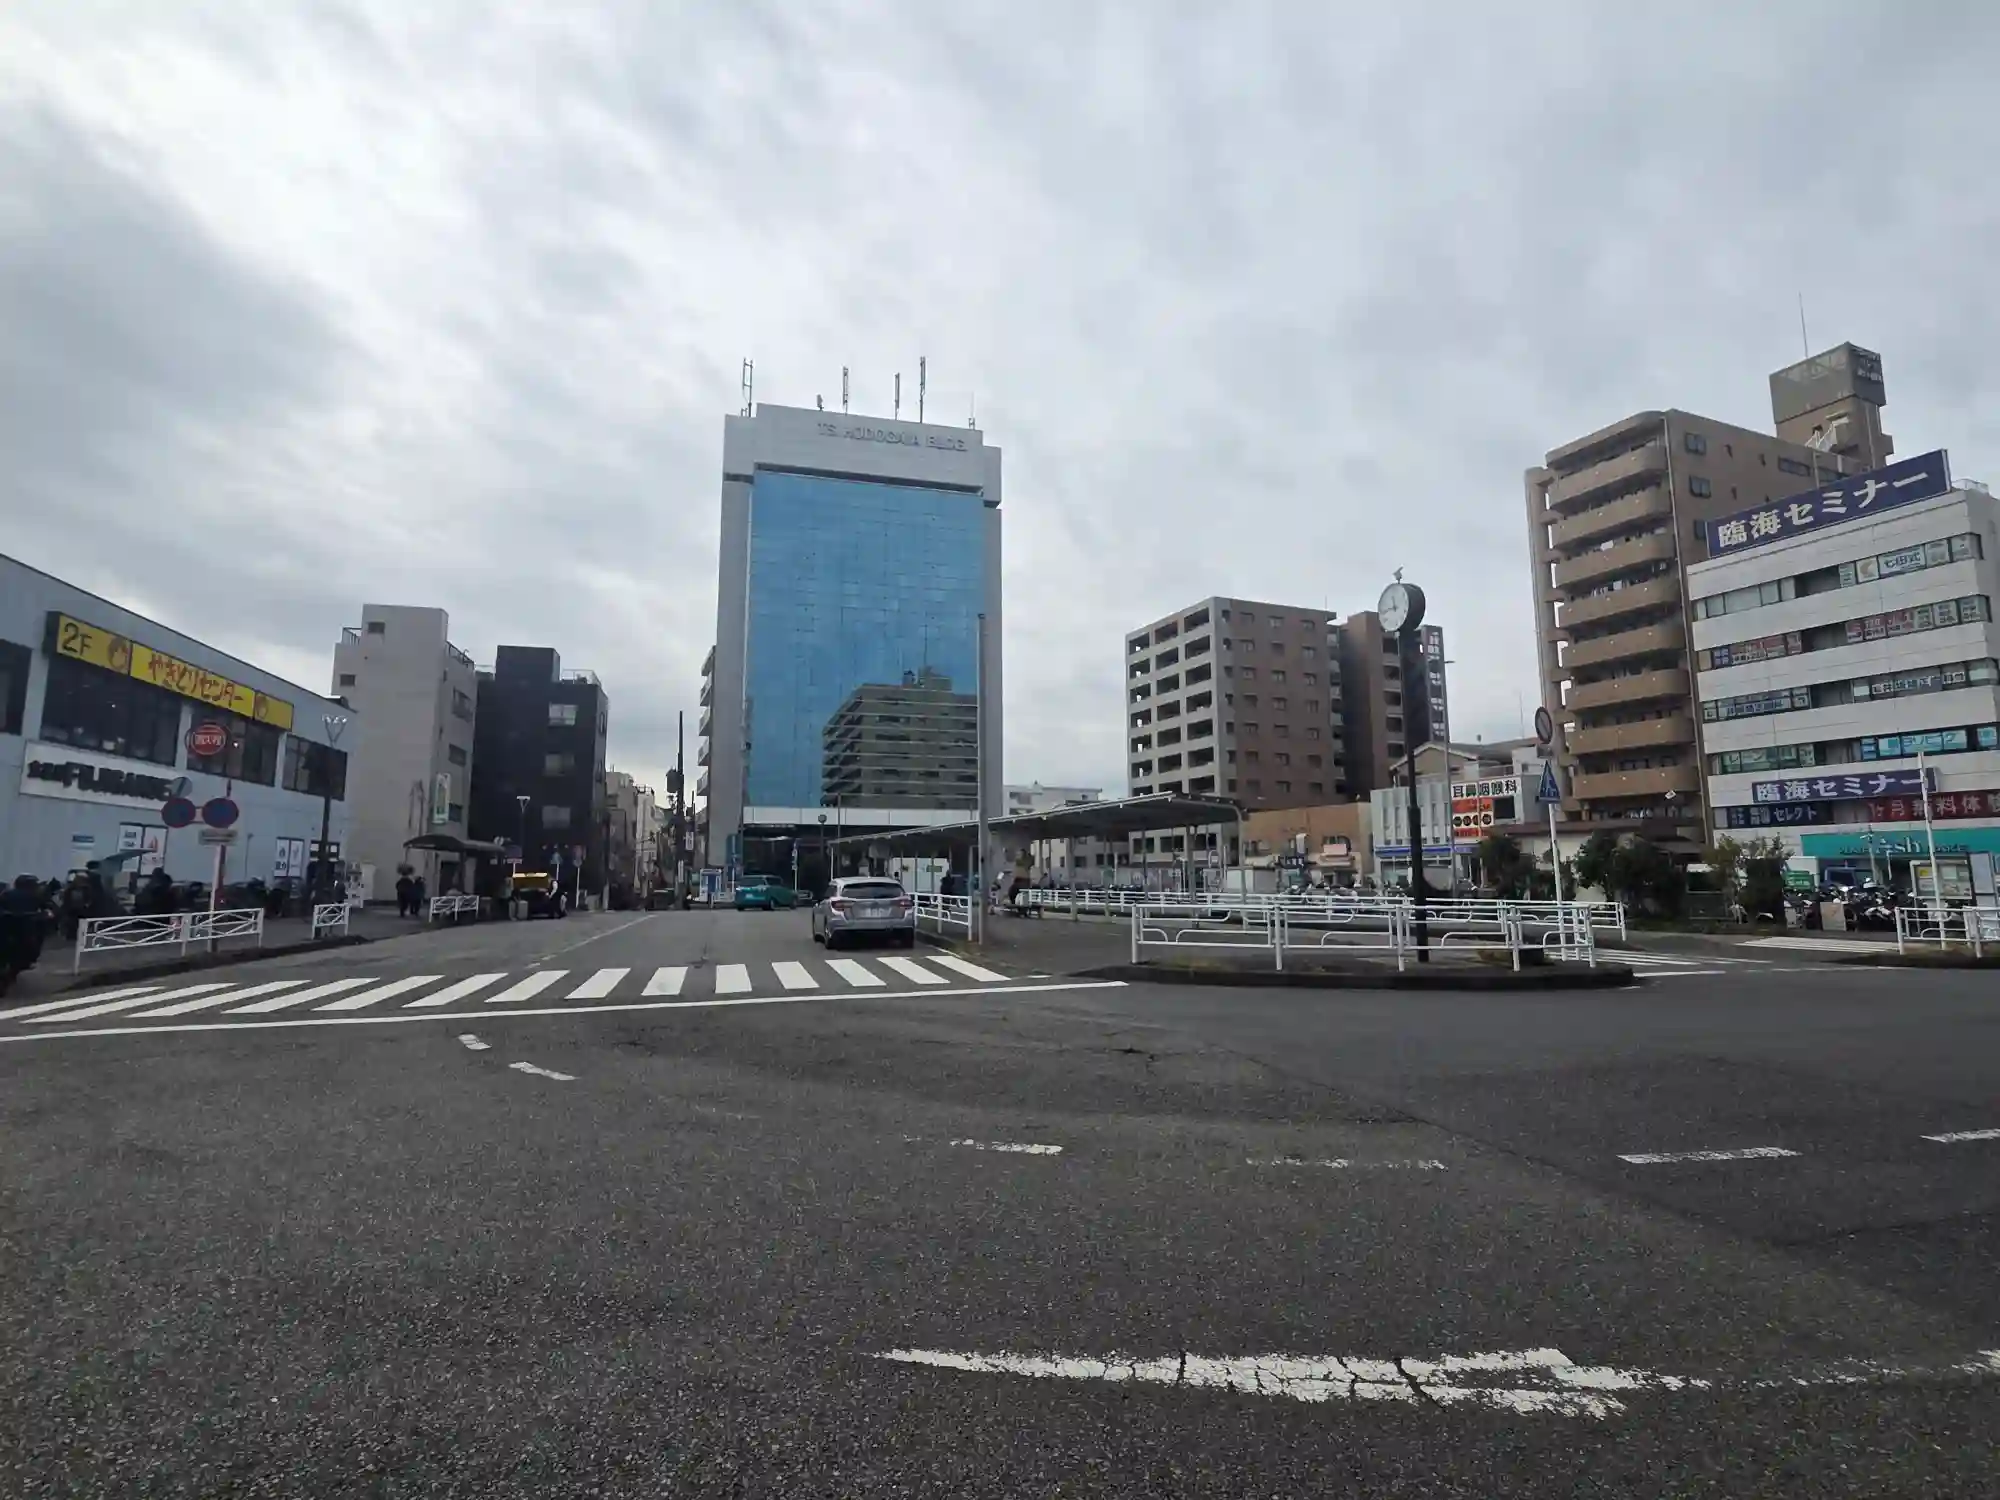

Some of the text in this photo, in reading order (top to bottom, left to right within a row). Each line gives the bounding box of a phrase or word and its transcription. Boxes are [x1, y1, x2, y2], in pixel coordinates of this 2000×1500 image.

[1717, 471, 1929, 548] 臨海セミナー
[61, 620, 93, 657] 2F
[147, 652, 245, 709] やきとりセンター
[1756, 773, 1925, 803] 臨海セミナー
